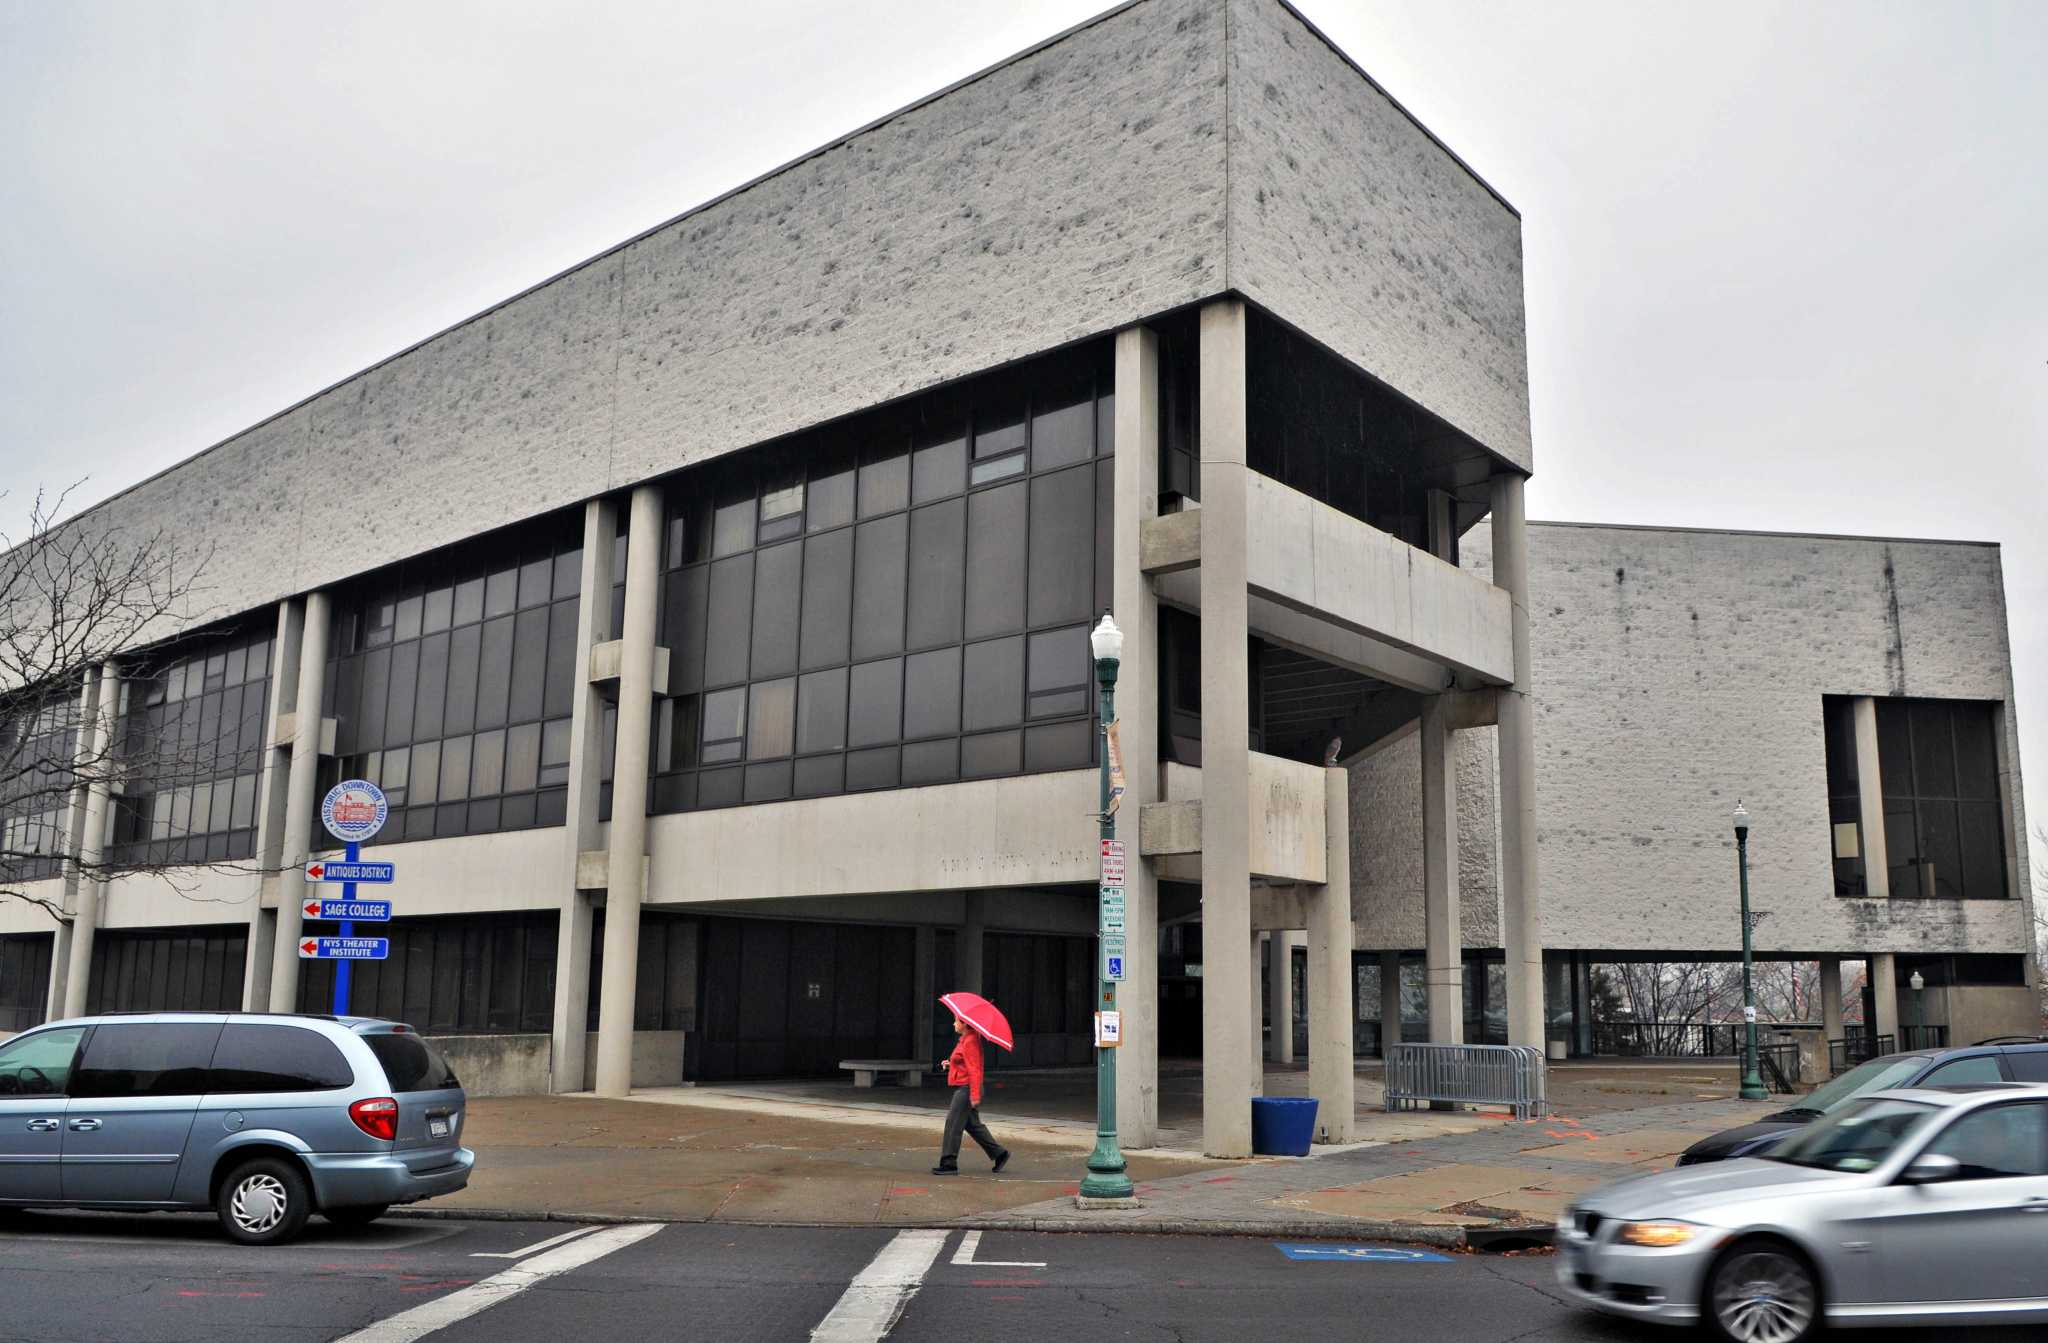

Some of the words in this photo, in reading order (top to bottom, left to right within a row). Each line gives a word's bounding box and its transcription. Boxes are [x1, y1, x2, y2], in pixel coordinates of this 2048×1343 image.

[323, 787, 342, 824] HISTORIC
[341, 781, 383, 802] DOWNTOWN
[376, 803, 386, 824] TROY
[326, 866, 360, 878] ANTIQUES
[361, 867, 392, 879] DISTRICT
[325, 903, 348, 916] SAGE
[348, 904, 386, 917] COLLEGE
[323, 939, 341, 948] NYS
[342, 940, 379, 949] THEATER
[329, 948, 372, 957] INSTITUTE
